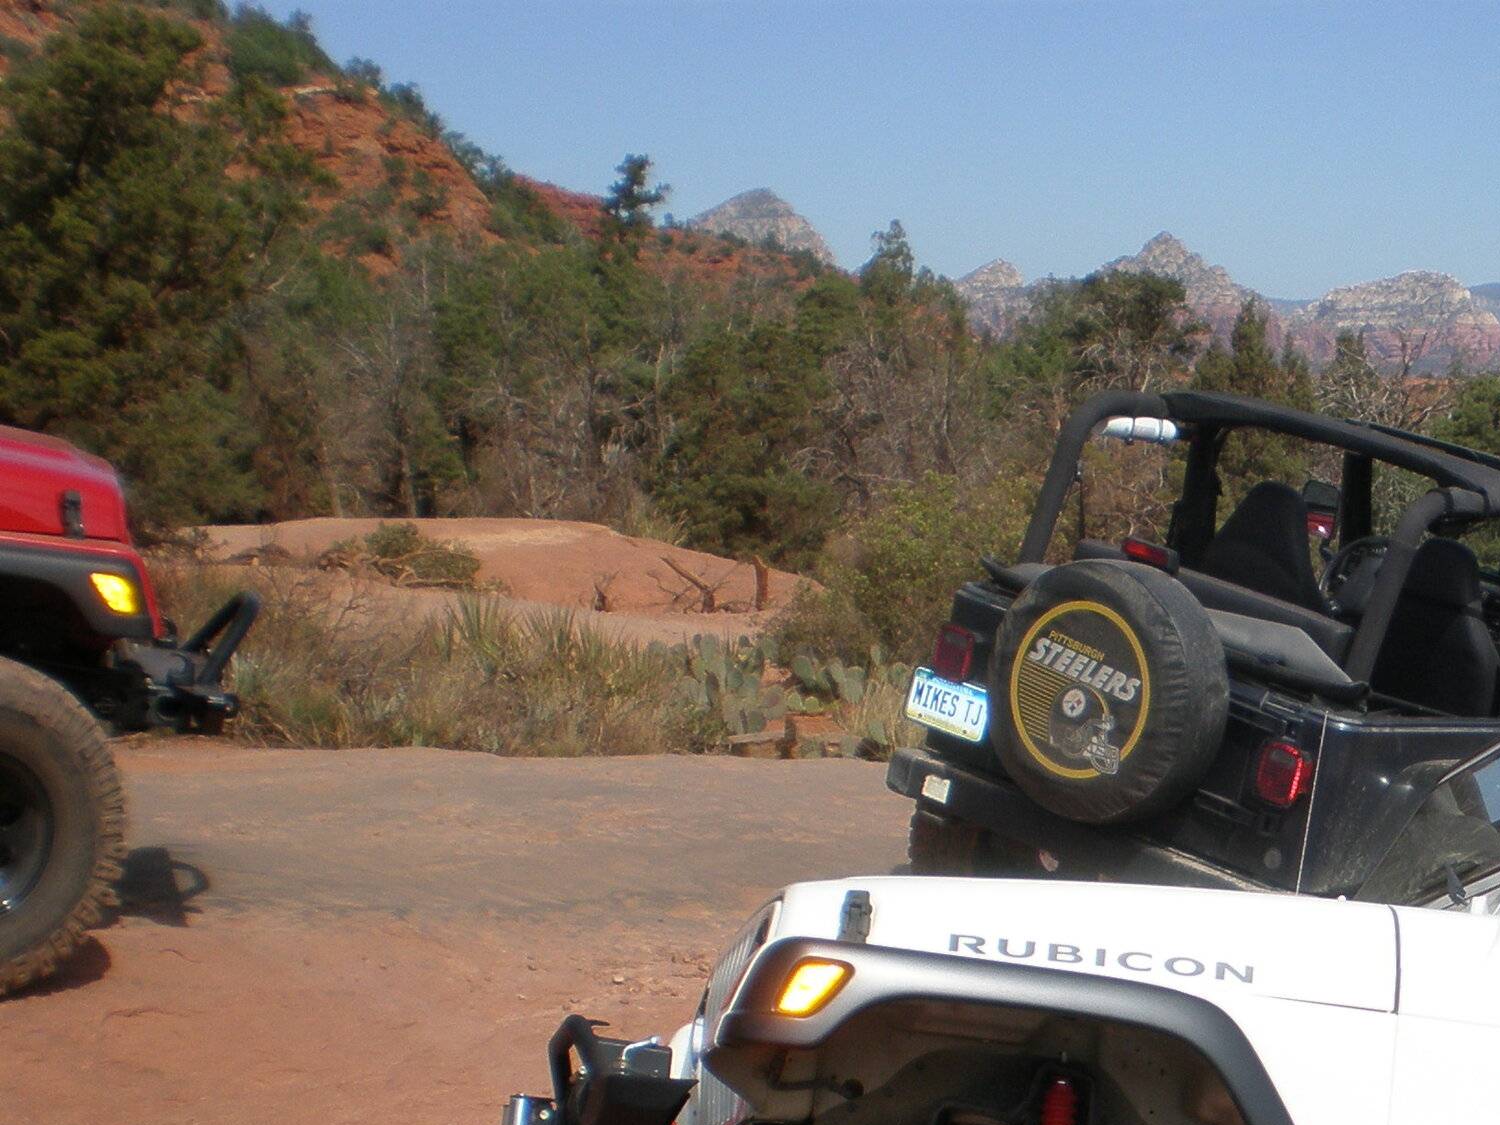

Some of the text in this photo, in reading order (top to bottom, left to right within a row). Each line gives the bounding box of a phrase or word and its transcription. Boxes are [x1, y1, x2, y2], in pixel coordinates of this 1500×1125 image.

[1028, 637, 1141, 701] STEELERS
[1048, 630, 1105, 661] PITTSBURGH
[912, 681, 960, 717] MIKES
[963, 699, 983, 726] TJ
[948, 933, 1254, 984] RUBICON
